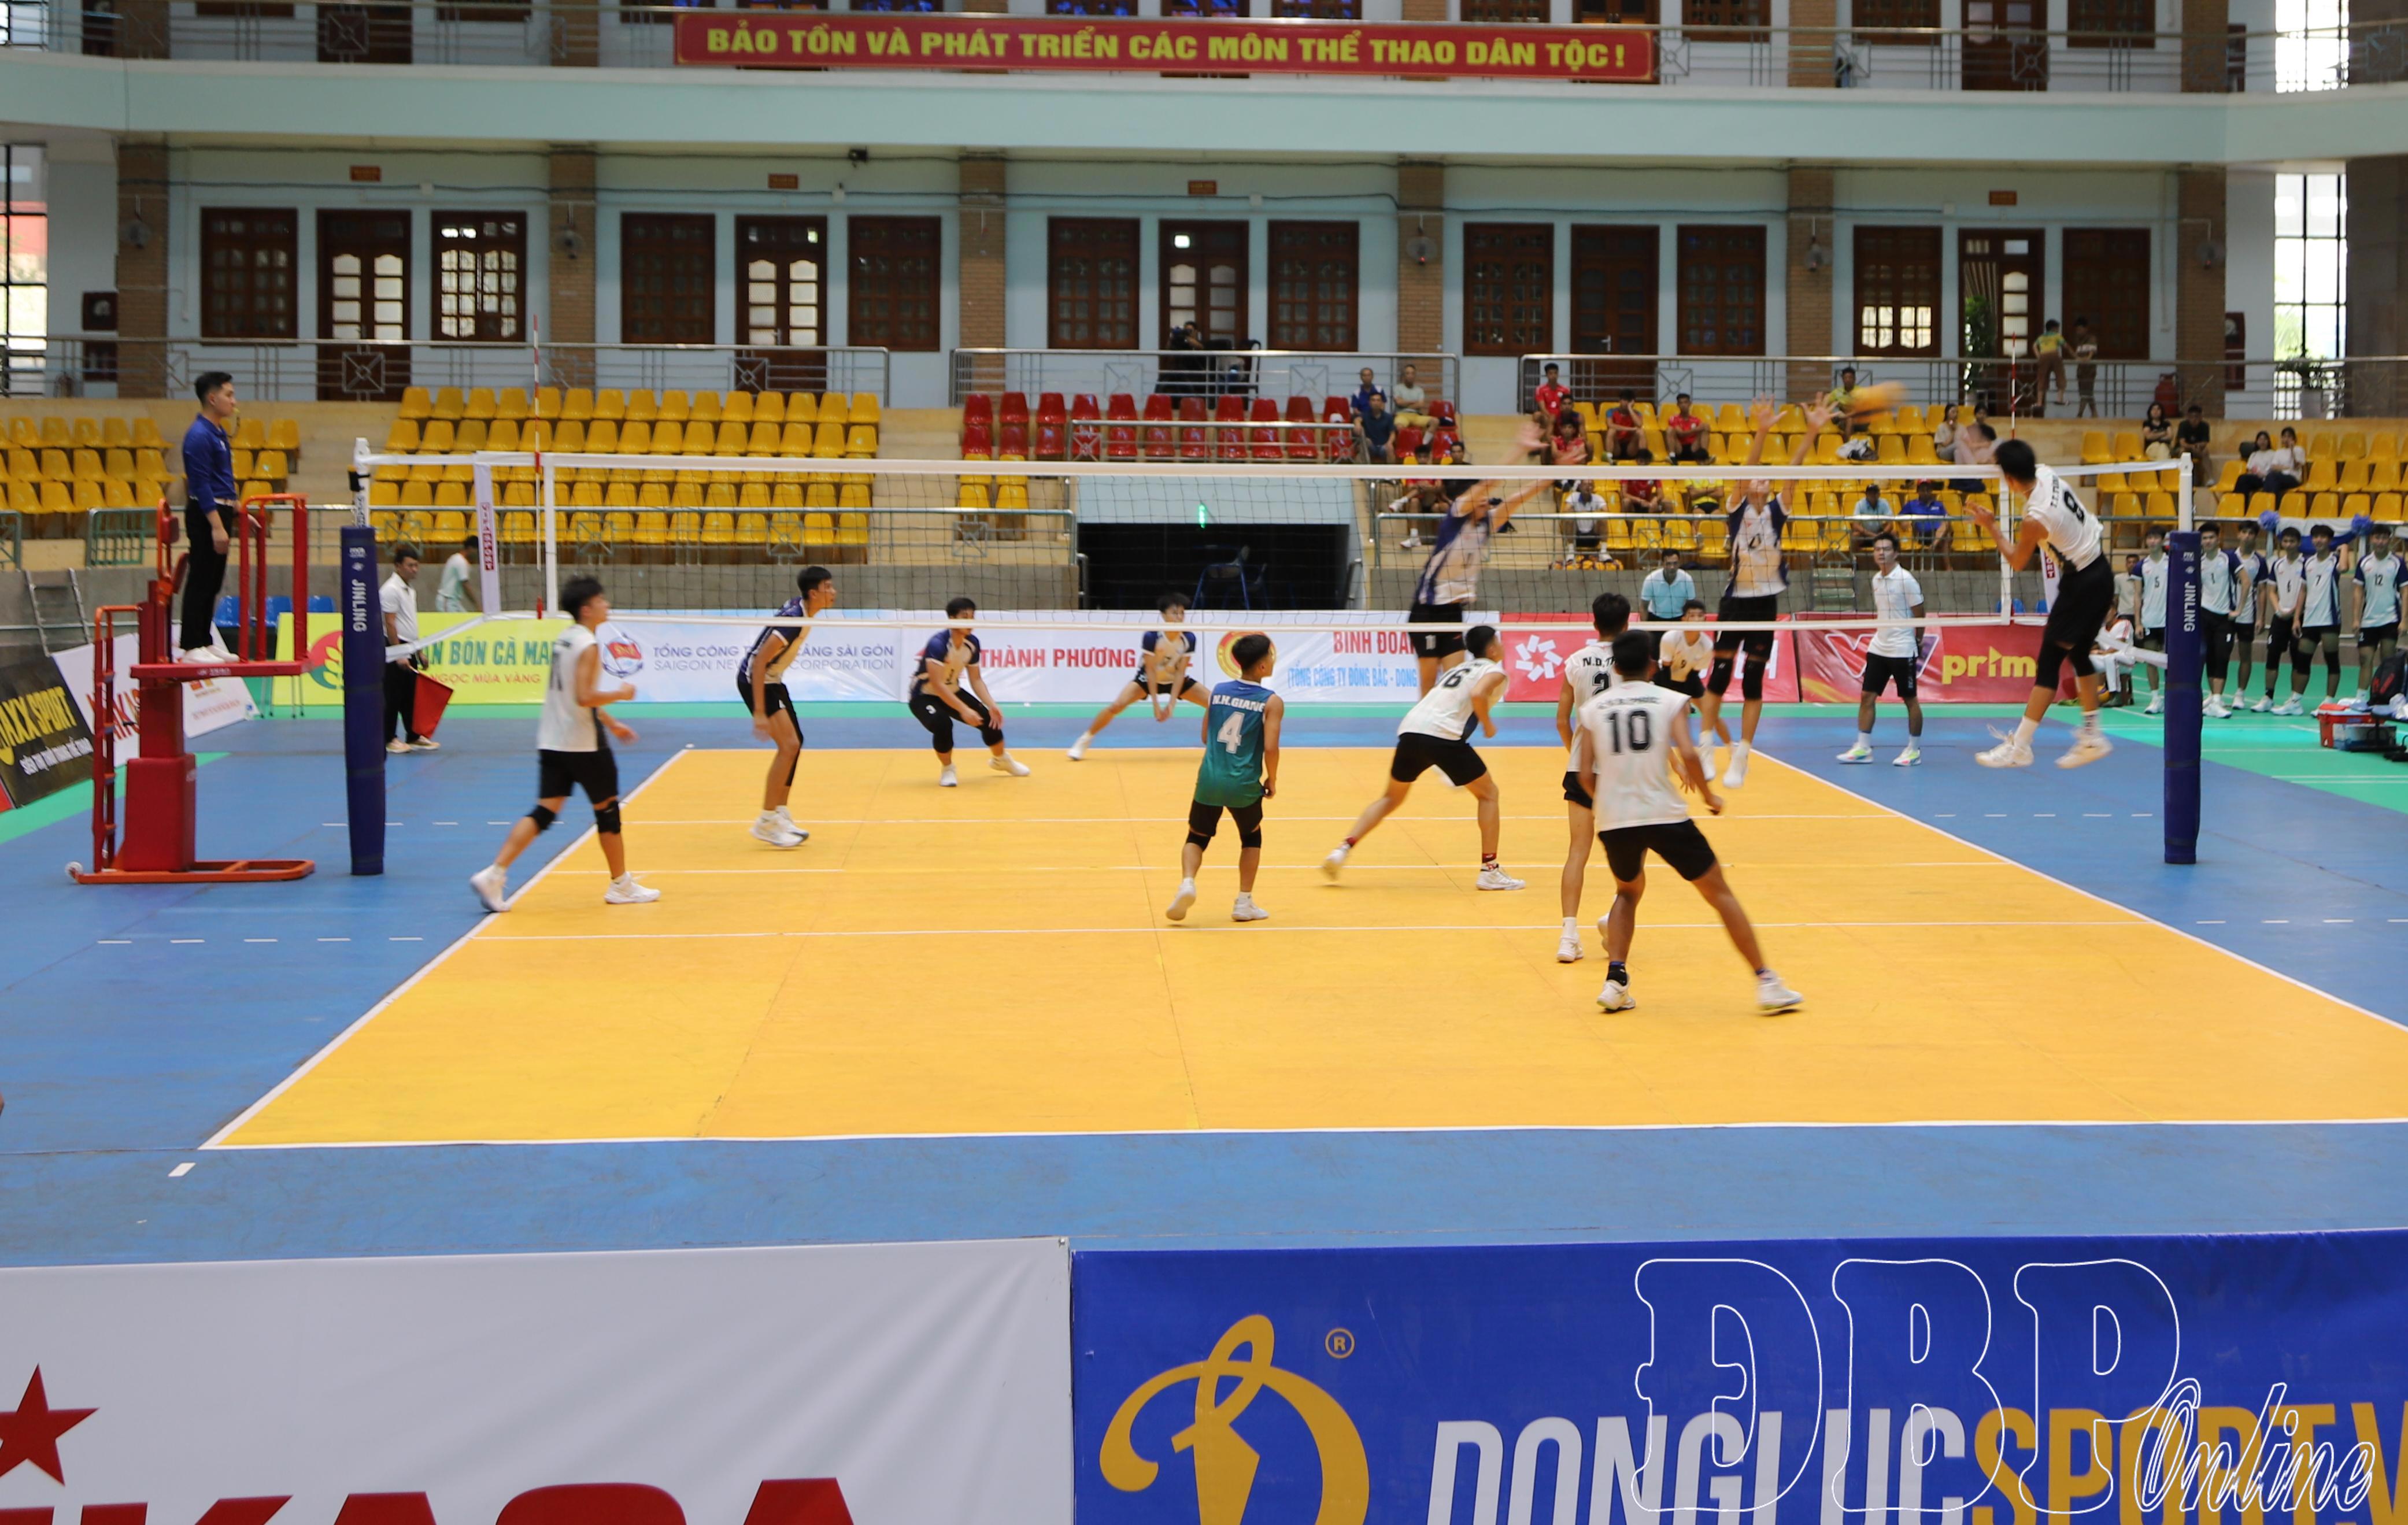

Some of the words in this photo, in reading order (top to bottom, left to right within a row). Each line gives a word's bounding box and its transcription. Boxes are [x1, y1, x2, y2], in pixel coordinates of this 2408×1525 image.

[708, 22, 776, 53] BẢO
[789, 25, 856, 54] TỒN
[867, 28, 911, 55] VÀ
[922, 29, 1009, 57] PHÁT
[1020, 27, 1118, 58] TRIỂN
[1129, 31, 1197, 60] CÁC
[1208, 32, 1288, 61] MÔN
[1299, 30, 1360, 62] THỂ
[1369, 40, 1456, 64] THAO
[1466, 38, 1536, 65] DÂN
[1546, 39, 1608, 71] TỘC
[2374, 574, 2383, 586] 12
[352, 579, 368, 632] JINLING
[2183, 582, 2196, 632] JINLING
[449, 636, 487, 665] BÓN
[492, 637, 517, 665] CÀ
[523, 641, 556, 665] MA
[653, 643, 692, 657] TỔNG
[696, 645, 739, 656] CÔNG
[836, 645, 857, 657] SÀI
[861, 644, 893, 656] GÒN
[654, 660, 712, 671] SAIGON
[790, 659, 893, 670] CORPORATION
[979, 645, 1045, 667] THÀNH
[1053, 646, 1136, 668] PHƯƠNG
[1942, 646, 2037, 684] prim
[472, 671, 500, 684] MÙA
[504, 671, 541, 684] VÀNG
[1592, 671, 1611, 695] 2
[27, 686, 77, 735] SPORT
[1216, 711, 1245, 754] 4
[1604, 708, 1651, 754] 10
